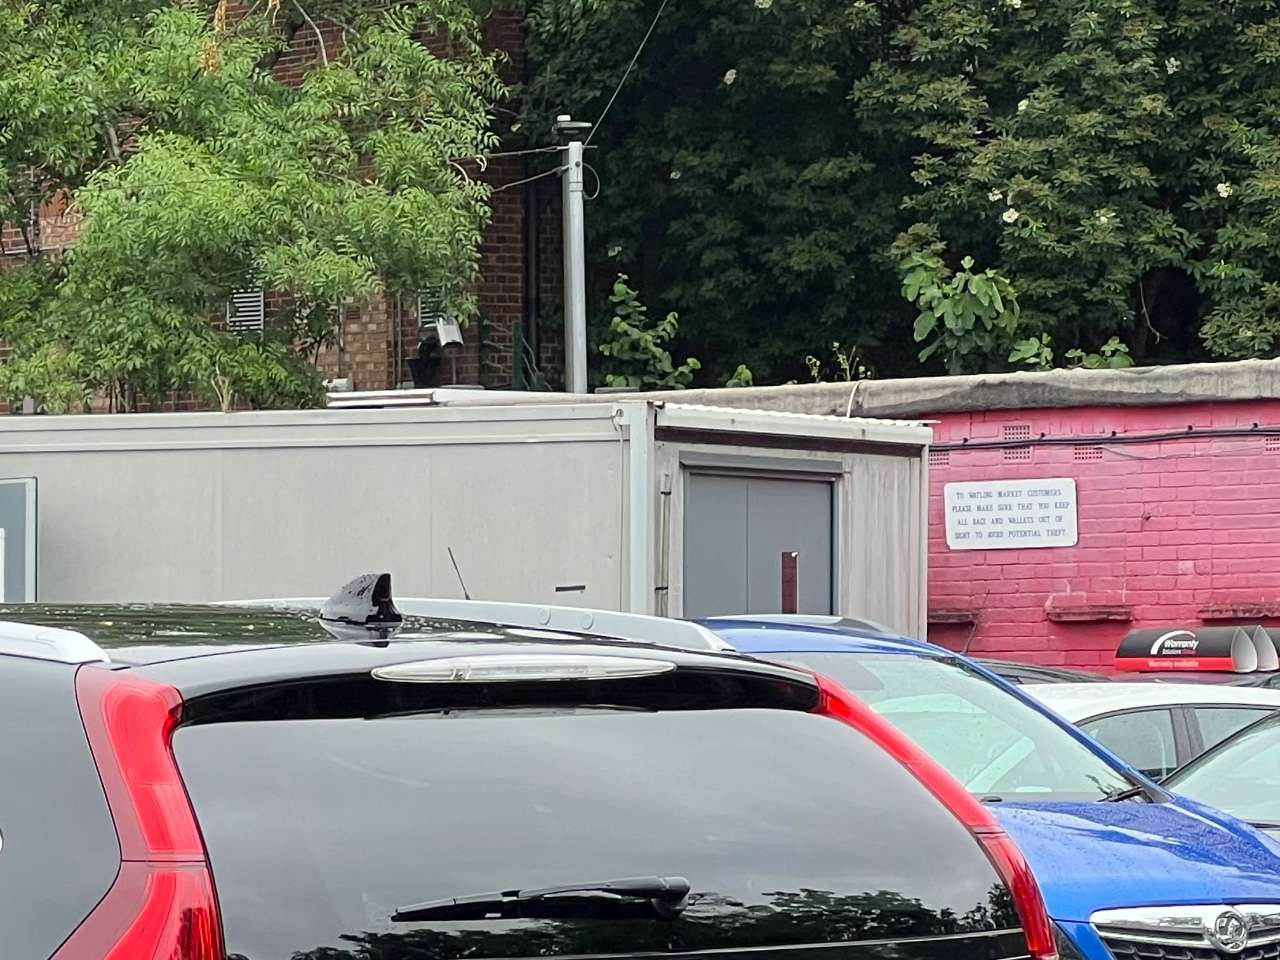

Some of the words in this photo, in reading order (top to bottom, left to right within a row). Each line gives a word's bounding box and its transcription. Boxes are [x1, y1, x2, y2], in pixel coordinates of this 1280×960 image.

[952, 504, 972, 512] PLEASE
[1054, 501, 1070, 509] KEEP
[1164, 640, 1199, 650] Warranty
